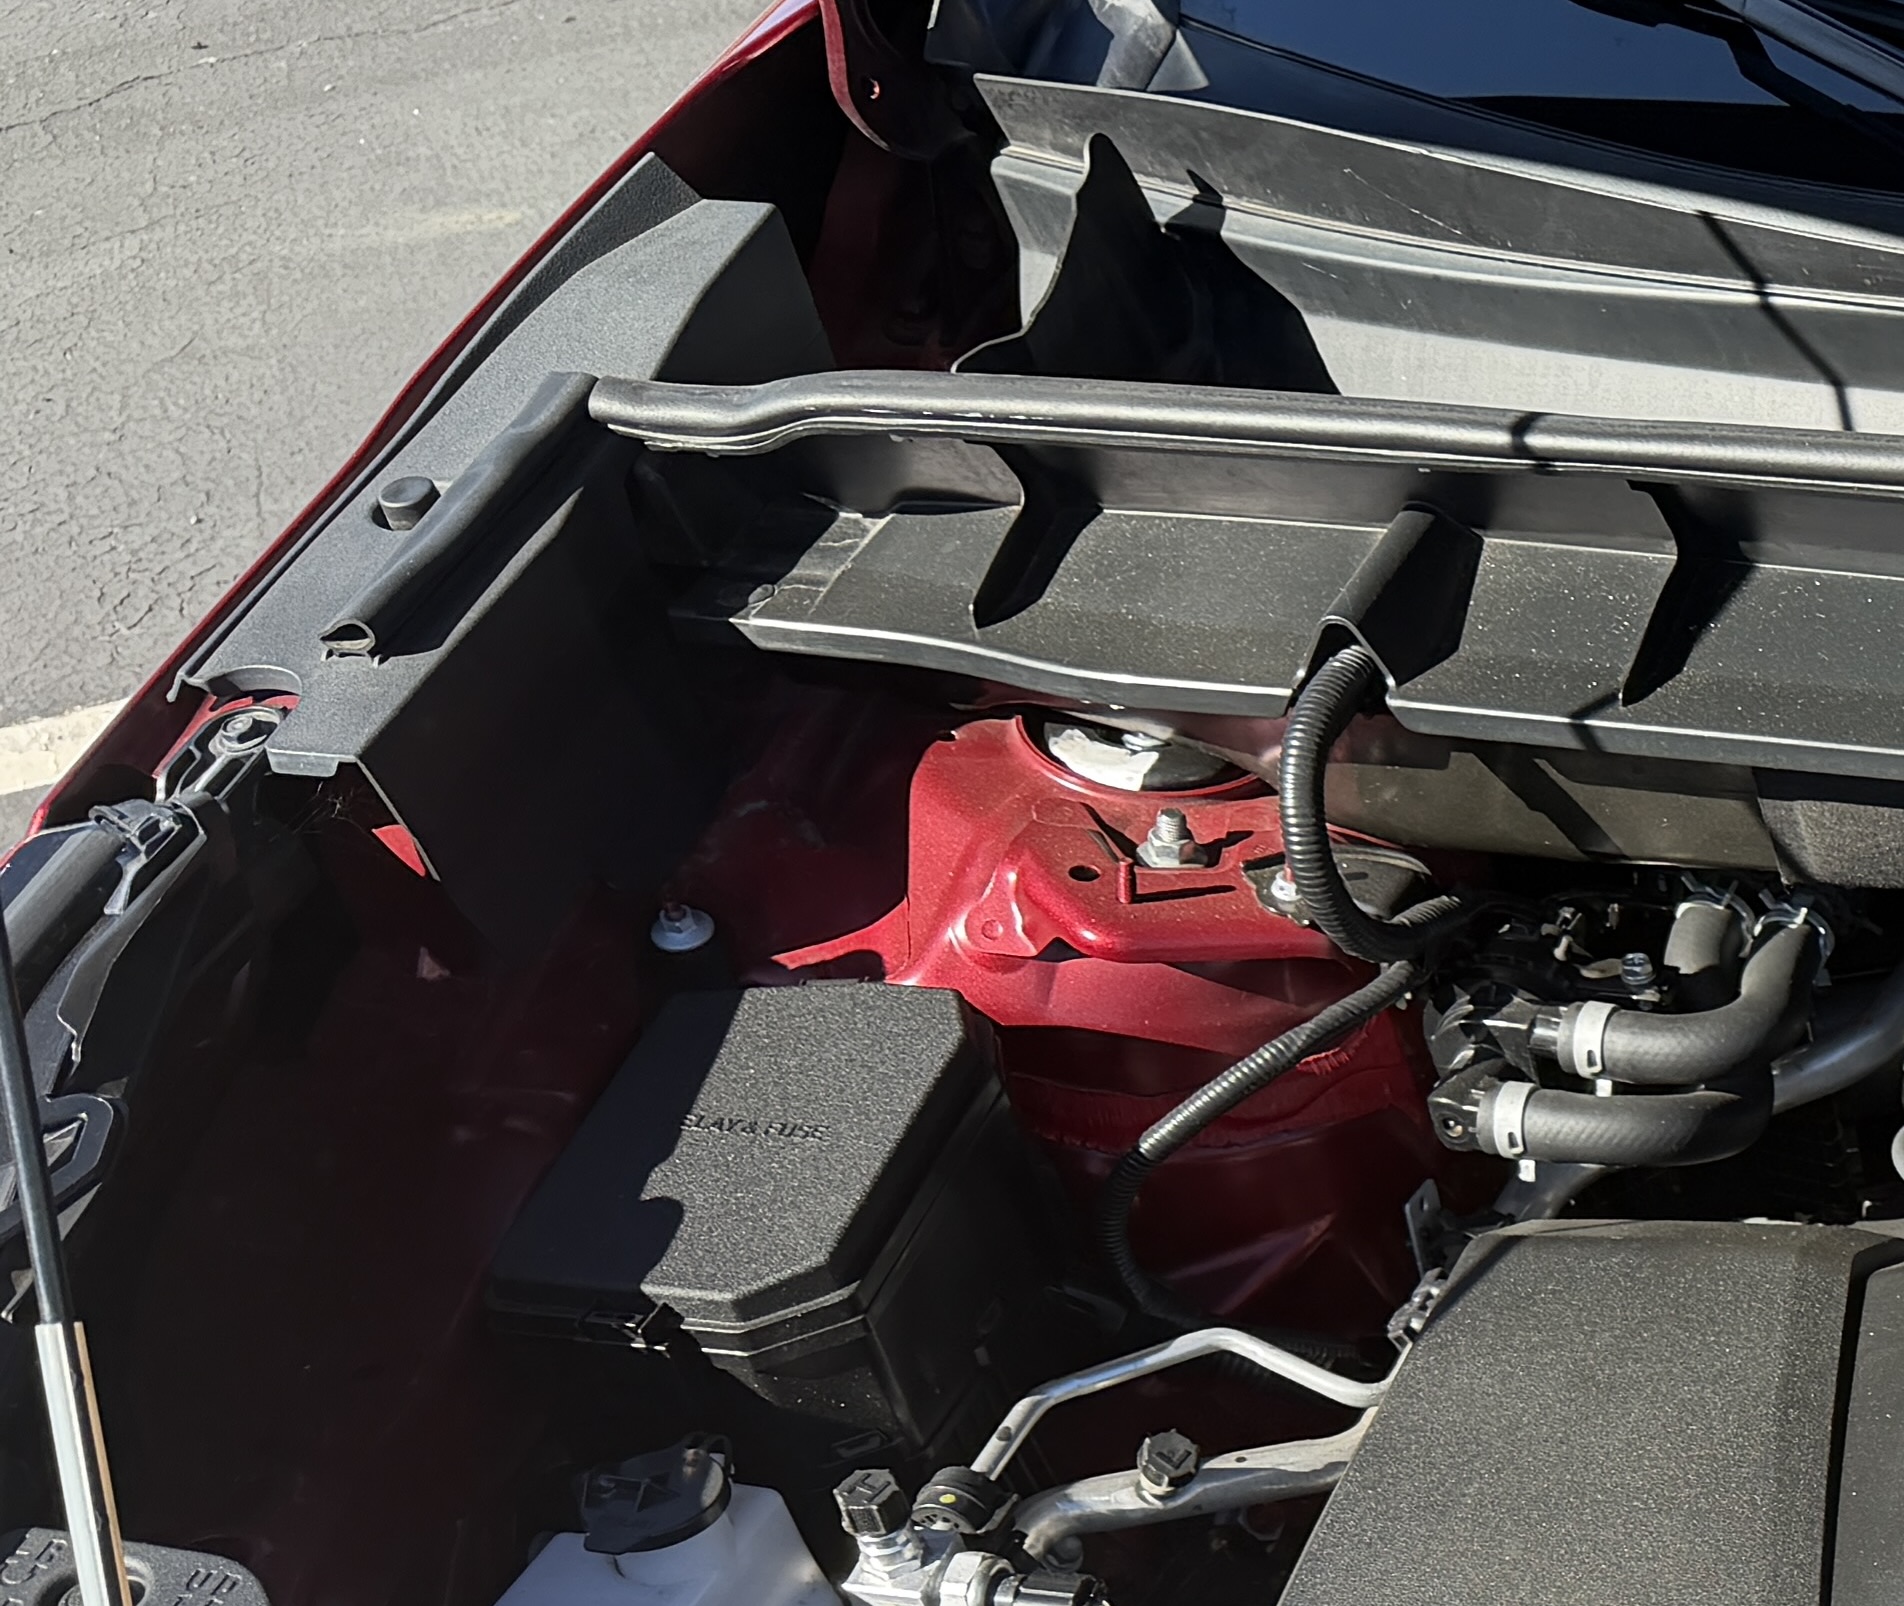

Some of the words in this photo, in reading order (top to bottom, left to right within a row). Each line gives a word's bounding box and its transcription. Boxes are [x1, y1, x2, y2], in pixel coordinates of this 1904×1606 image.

[679, 1113, 744, 1134] ELAY
[763, 1121, 833, 1142] FUSE
[185, 1567, 243, 1596] UP
